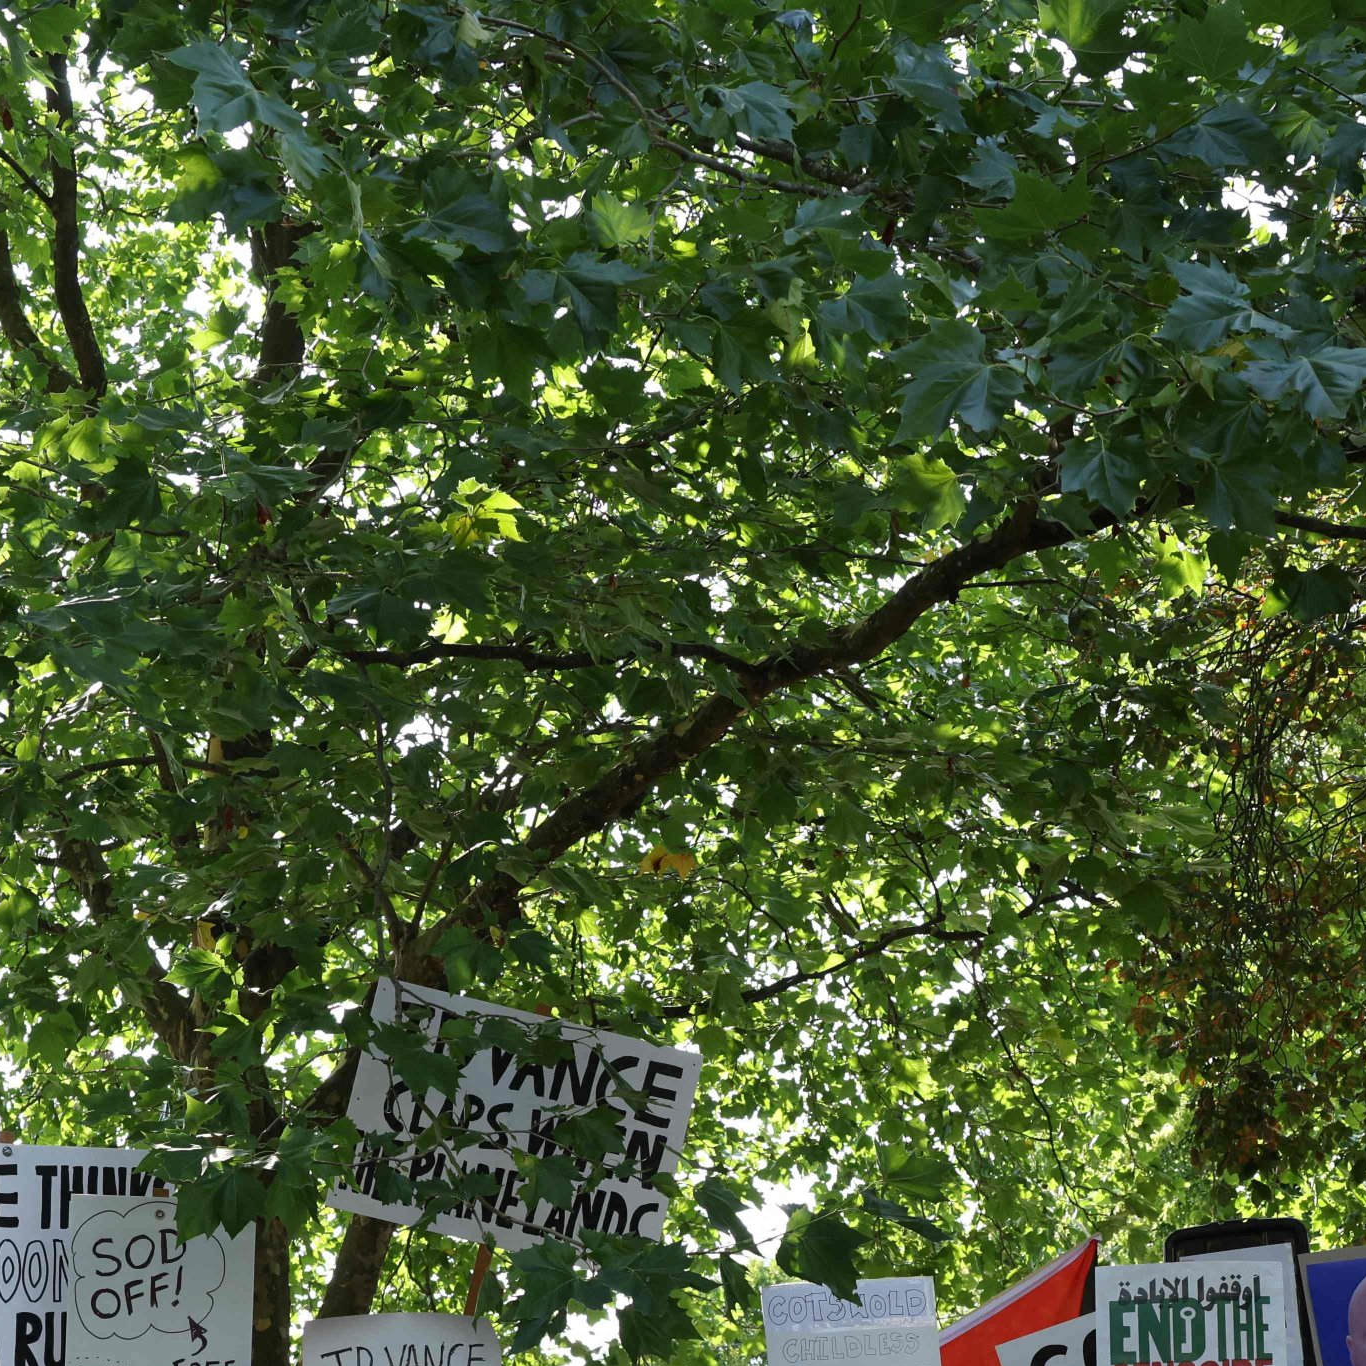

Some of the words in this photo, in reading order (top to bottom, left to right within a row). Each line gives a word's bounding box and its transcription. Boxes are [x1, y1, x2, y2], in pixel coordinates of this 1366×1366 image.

[92, 1229, 186, 1277] SOD
[91, 1265, 183, 1319] OFF!
[768, 1289, 927, 1325] COTSWOLD
[783, 1333, 920, 1363] CHILDLESS
[1108, 1297, 1206, 1365] END
[1212, 1296, 1273, 1362] THE
